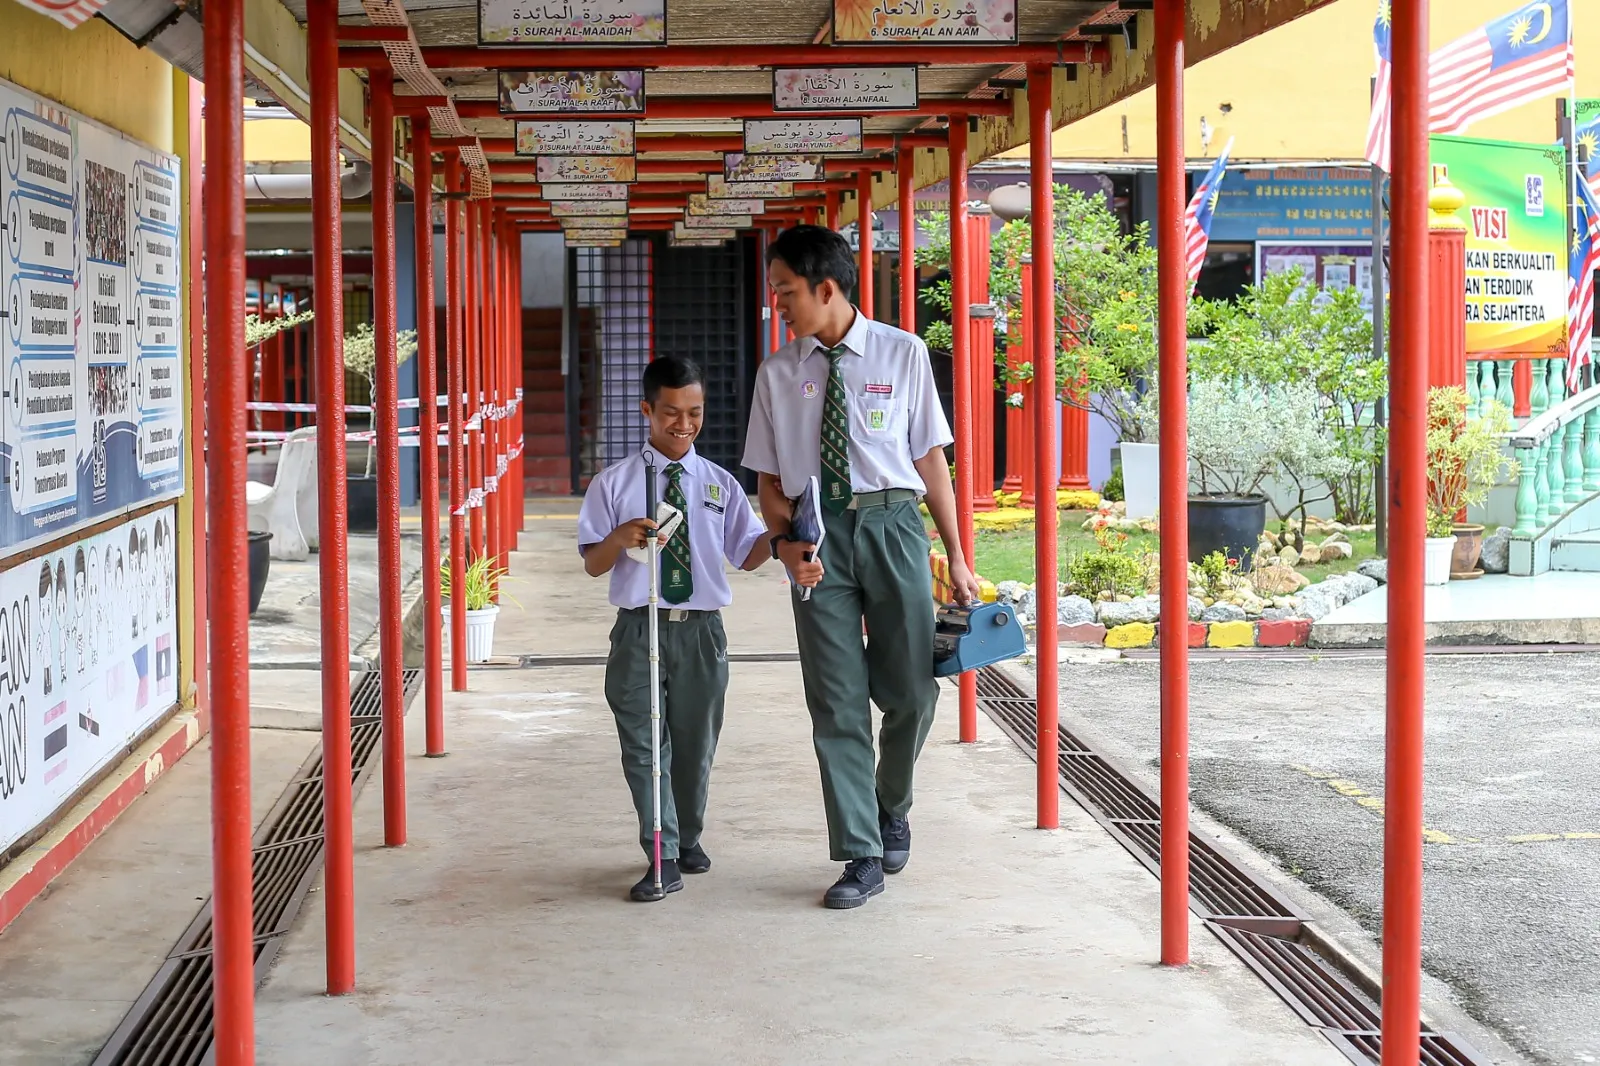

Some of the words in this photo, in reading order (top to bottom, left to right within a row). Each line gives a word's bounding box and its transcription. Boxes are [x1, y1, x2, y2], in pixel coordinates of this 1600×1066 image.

[513, 27, 521, 36] 5.
[524, 27, 562, 36] SURAH
[564, 27, 632, 36] AL-MAAIDAH
[871, 28, 879, 36] 6.
[882, 28, 920, 36] SURAH
[922, 28, 936, 36] AL
[938, 28, 954, 36] AN
[11, 128, 15, 160] 1
[12, 211, 16, 242] 2
[1472, 208, 1507, 239] VISI
[1494, 252, 1555, 271] BERKUALITI
[1484, 278, 1534, 296] TERDIDIK
[14, 294, 18, 326] 3
[1484, 304, 1545, 321] SEJAHTERA
[14, 378, 18, 408] 4
[15, 461, 19, 492] 5
